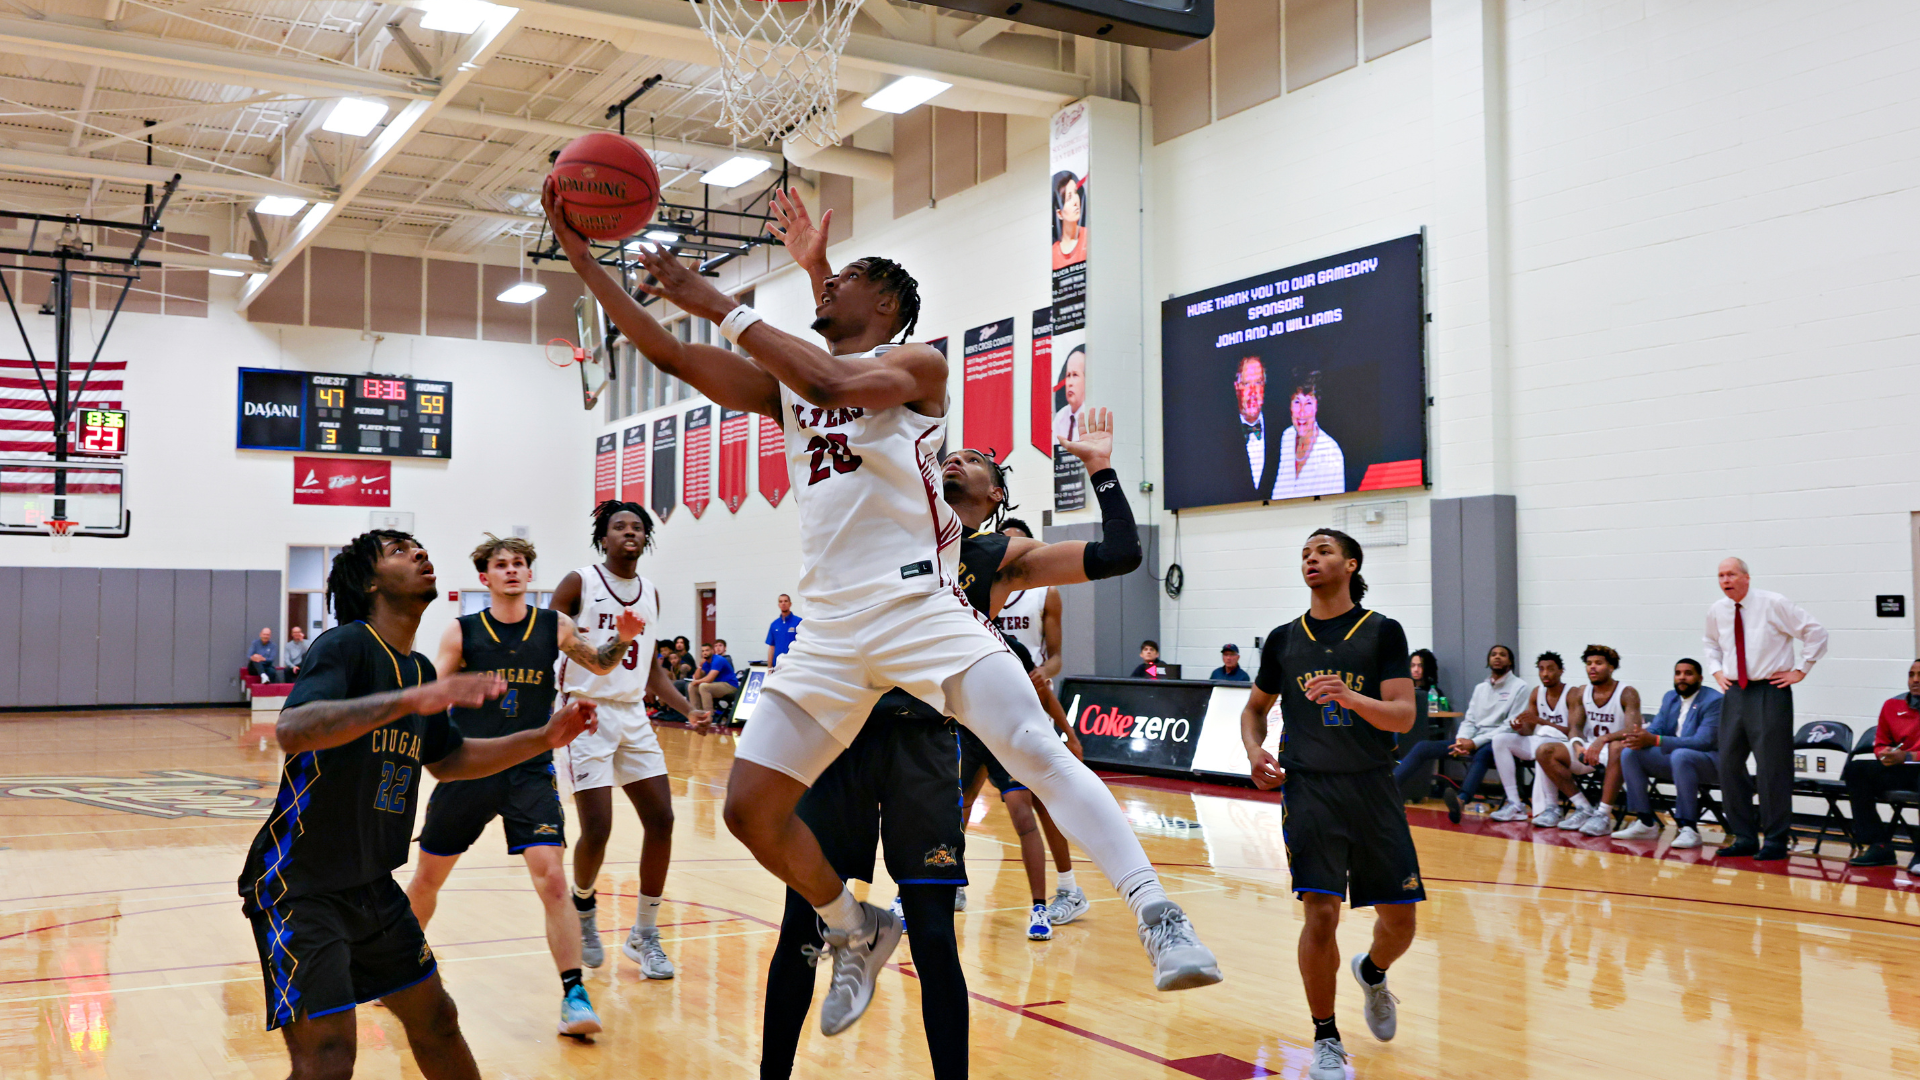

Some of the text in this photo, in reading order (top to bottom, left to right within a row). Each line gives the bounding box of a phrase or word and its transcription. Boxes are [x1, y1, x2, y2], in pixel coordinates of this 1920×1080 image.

[557, 174, 626, 200] SPALDING
[1186, 257, 1379, 318] HUGE THANK YOU TO OUR GAMEDAY
[1247, 295, 1305, 321] SPONSOR!
[1215, 308, 1343, 348] JOHN AND JO WILLIAMS
[312, 375, 348, 386] GUEST
[363, 378, 407, 401] 13:36
[415, 382, 446, 393] HOME
[244, 401, 299, 418] DASANI
[319, 388, 345, 408] 47
[420, 394, 445, 415] 59
[86, 411, 125, 428] 13:36
[85, 426, 119, 451] 23
[325, 428, 337, 444] 3
[430, 435, 438, 449] 1
[804, 433, 863, 487] 20
[501, 688, 519, 719] 4
[1321, 692, 1354, 727] 21
[373, 760, 413, 815] 22
